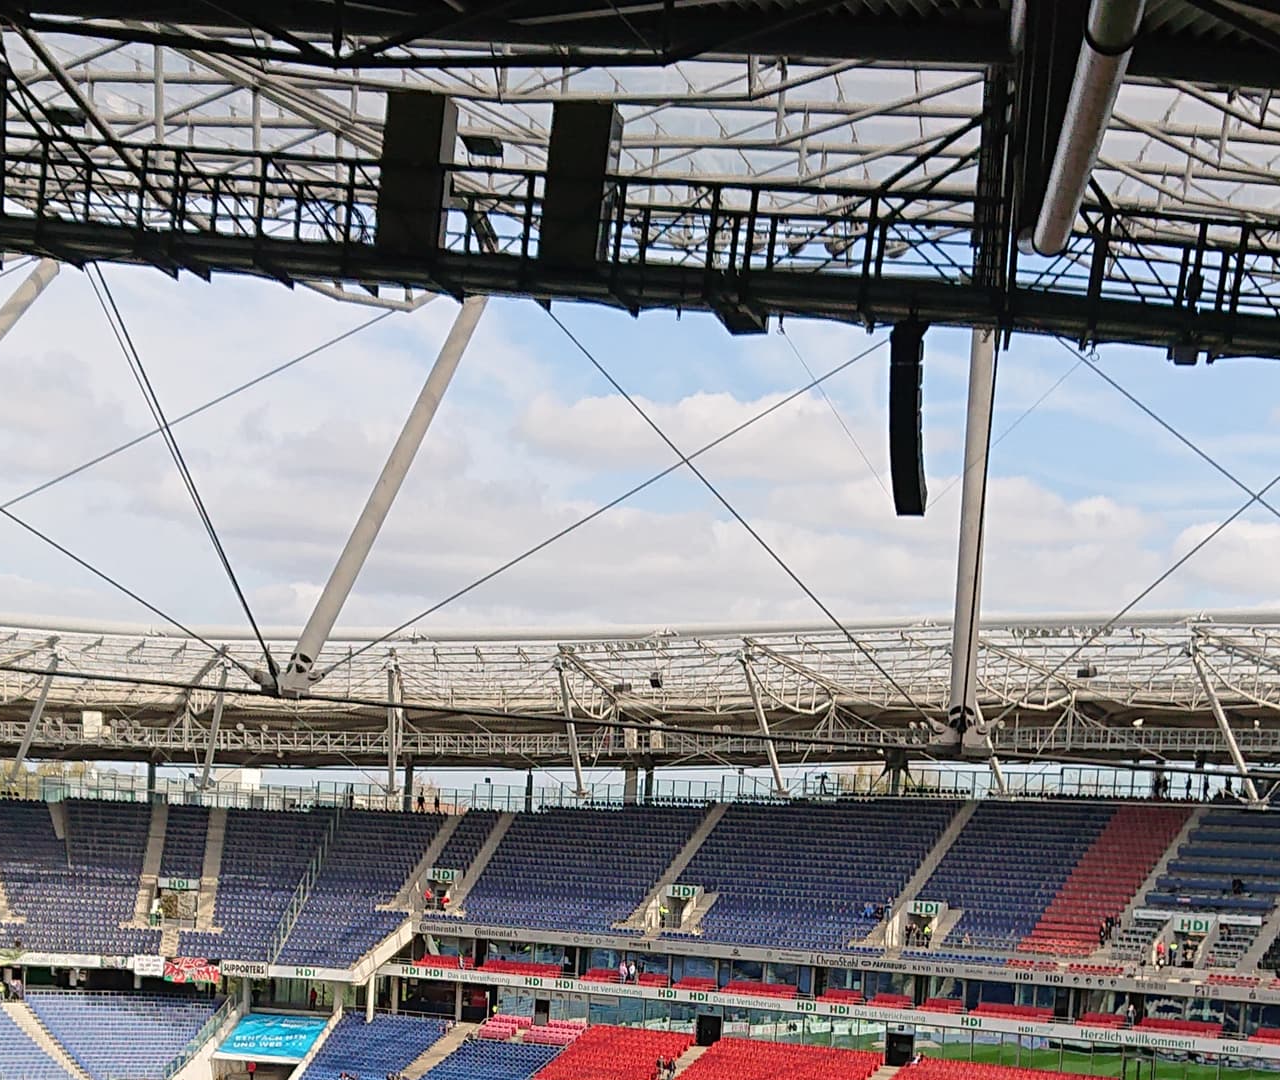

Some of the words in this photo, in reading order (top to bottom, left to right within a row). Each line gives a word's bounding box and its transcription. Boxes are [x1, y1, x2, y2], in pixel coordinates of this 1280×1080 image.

[432, 869, 455, 880] HDI
[168, 879, 189, 889] HDI
[671, 885, 696, 896] HDI
[913, 901, 939, 913] HDI
[1180, 919, 1209, 932] HDI
[223, 962, 265, 975] SUPPORTERS
[296, 967, 316, 977] HDI
[401, 967, 420, 976] HDI
[425, 968, 443, 977] HDI
[525, 978, 543, 987] HDI
[555, 980, 573, 989] HDI
[658, 989, 677, 999] HDI
[689, 992, 708, 1002] HDI
[797, 1001, 817, 1012] HDI
[830, 1004, 850, 1014] HDI
[961, 1017, 982, 1027] HDI
[1080, 1028, 1122, 1041] Herzlich
[1126, 1035, 1196, 1048] willkommen!
[1222, 1045, 1239, 1053] HDI
